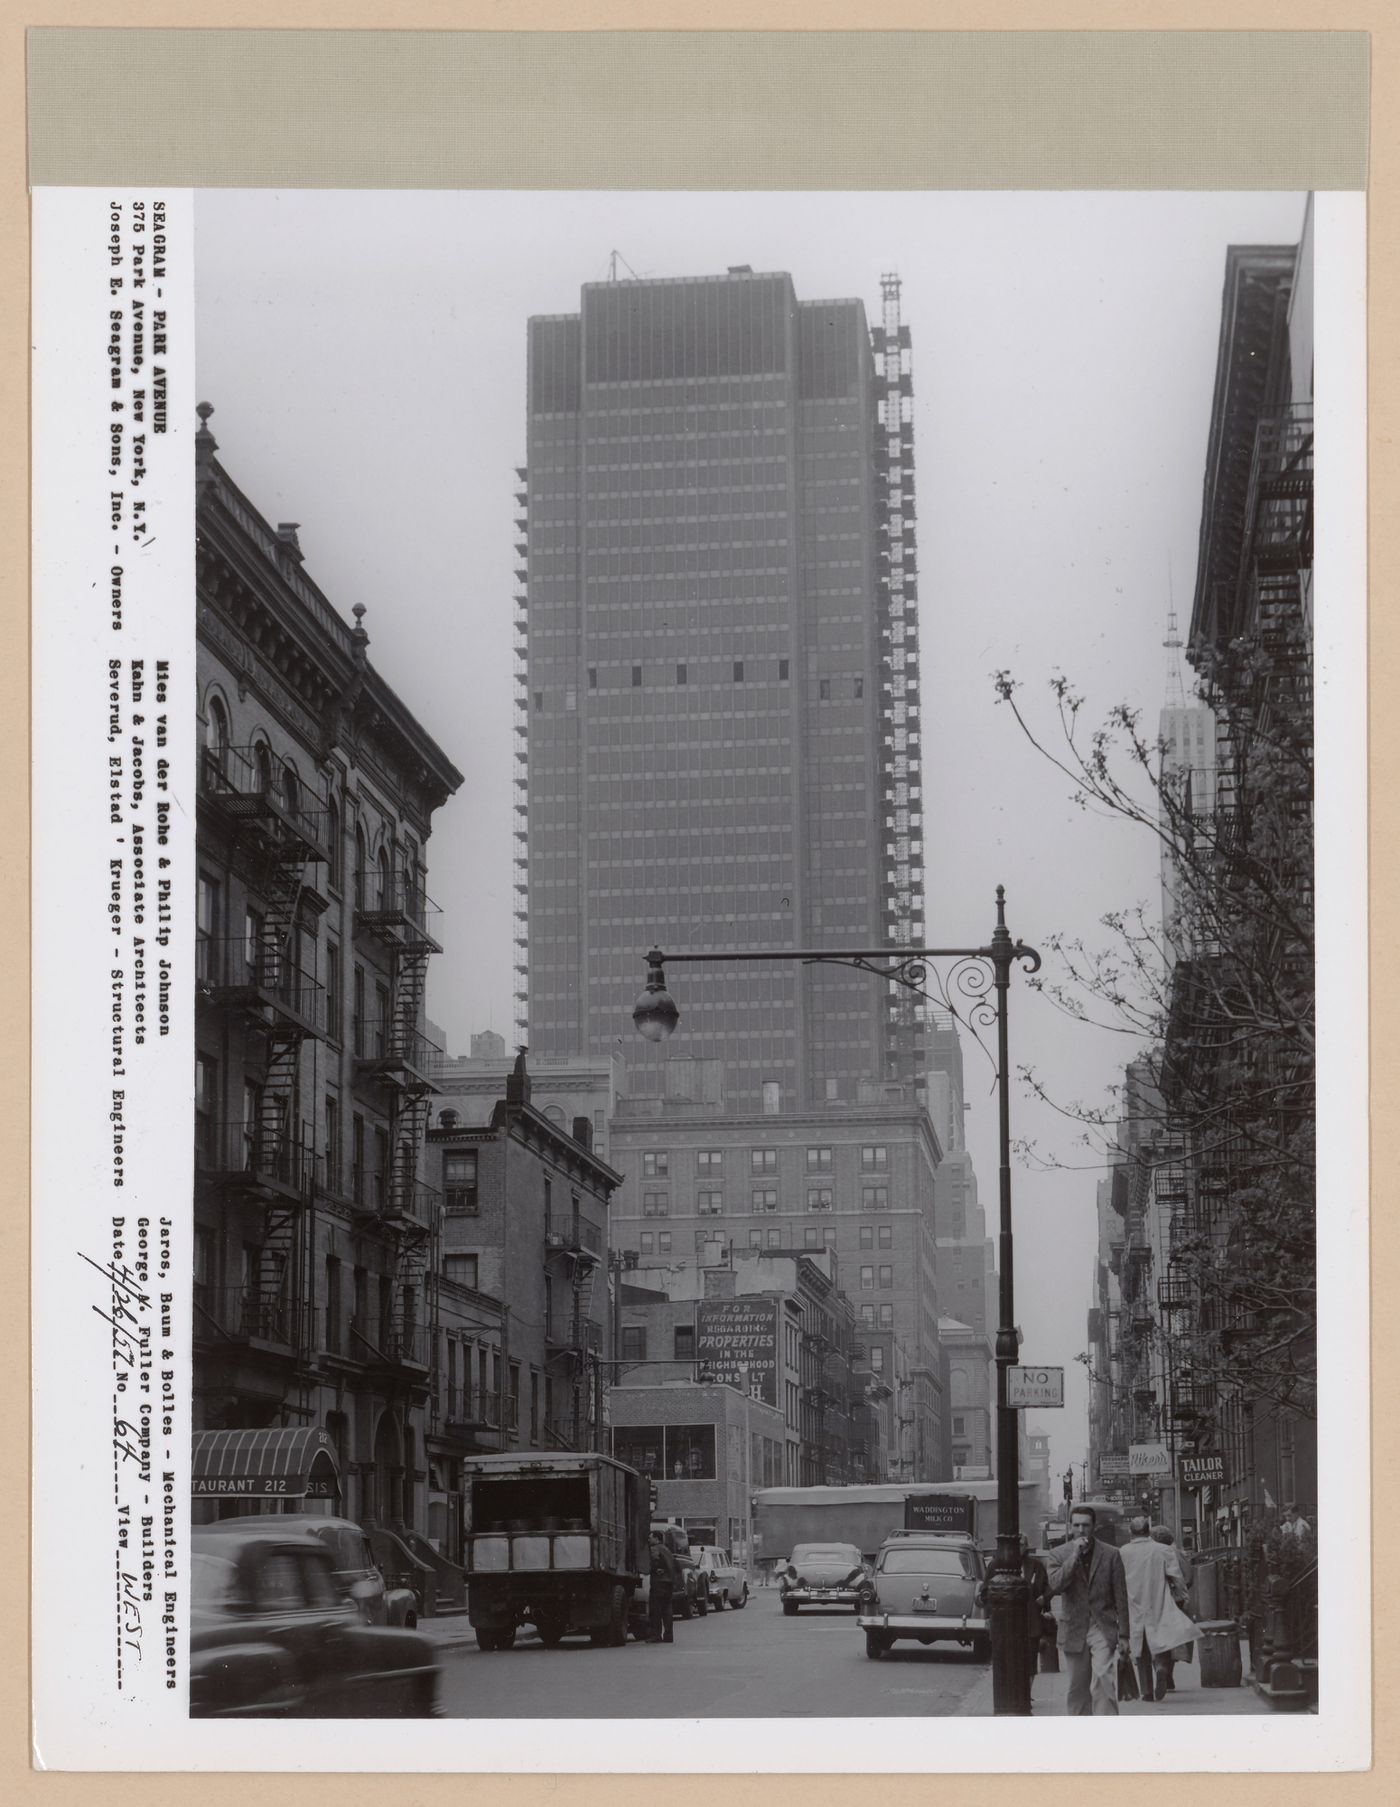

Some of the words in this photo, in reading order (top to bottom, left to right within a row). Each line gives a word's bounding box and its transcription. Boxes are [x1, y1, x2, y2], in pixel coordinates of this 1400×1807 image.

[108, 202, 123, 267] Joseph
[133, 202, 145, 233] 375
[153, 202, 166, 278] SEAGRAM
[110, 278, 123, 296] E.
[133, 245, 145, 289] Park
[108, 311, 123, 389] Seagram
[130, 300, 145, 374] Avenue,
[153, 311, 167, 356] PARK
[111, 401, 123, 412] &
[133, 390, 146, 423] New
[153, 366, 167, 434] AVENUE
[108, 423, 123, 476] Sons,
[130, 434, 146, 487] York,
[111, 491, 123, 531] Inc.
[133, 501, 147, 542] N.Y.
[111, 566, 123, 631] Owners
[108, 660, 122, 743] Severud,
[132, 660, 145, 703] Kahn
[156, 660, 169, 703] Mies
[133, 714, 145, 726] &
[156, 715, 167, 748] van
[110, 757, 123, 825] Elstad
[130, 736, 145, 810] Jacobs,
[156, 758, 169, 791] der
[157, 802, 170, 846] Rohe
[133, 824, 146, 925] Associate
[159, 858, 171, 869] &
[108, 858, 123, 936] Krueger
[156, 880, 171, 947] Philip
[133, 937, 146, 1046] Architects
[158, 959, 172, 1037] Johnson
[111, 969, 124, 1077] Structural
[109, 1089, 125, 1188] Engineers
[135, 1217, 149, 1283] George
[157, 1217, 172, 1280] Jaros,
[160, 1293, 172, 1338] Baum
[722, 1305, 751, 1313] FOR
[138, 1327, 152, 1394] Fuller
[161, 1349, 173, 1361] &
[699, 1335, 774, 1348] PROPERTIES
[734, 1350, 754, 1358] THE
[161, 1370, 174, 1436] Bolles
[1014, 1388, 1057, 1398] PARKING
[1024, 1373, 1048, 1384] NO
[135, 1403, 152, 1483] Company
[1181, 1457, 1223, 1472] TAILOR
[265, 1480, 286, 1492] 212
[1184, 1472, 1223, 1482] CLEANER
[162, 1471, 176, 1580] Mechanical
[141, 1516, 154, 1602] Builders
[121, 1572, 143, 1658] WEST
[162, 1591, 176, 1689] Engineers
